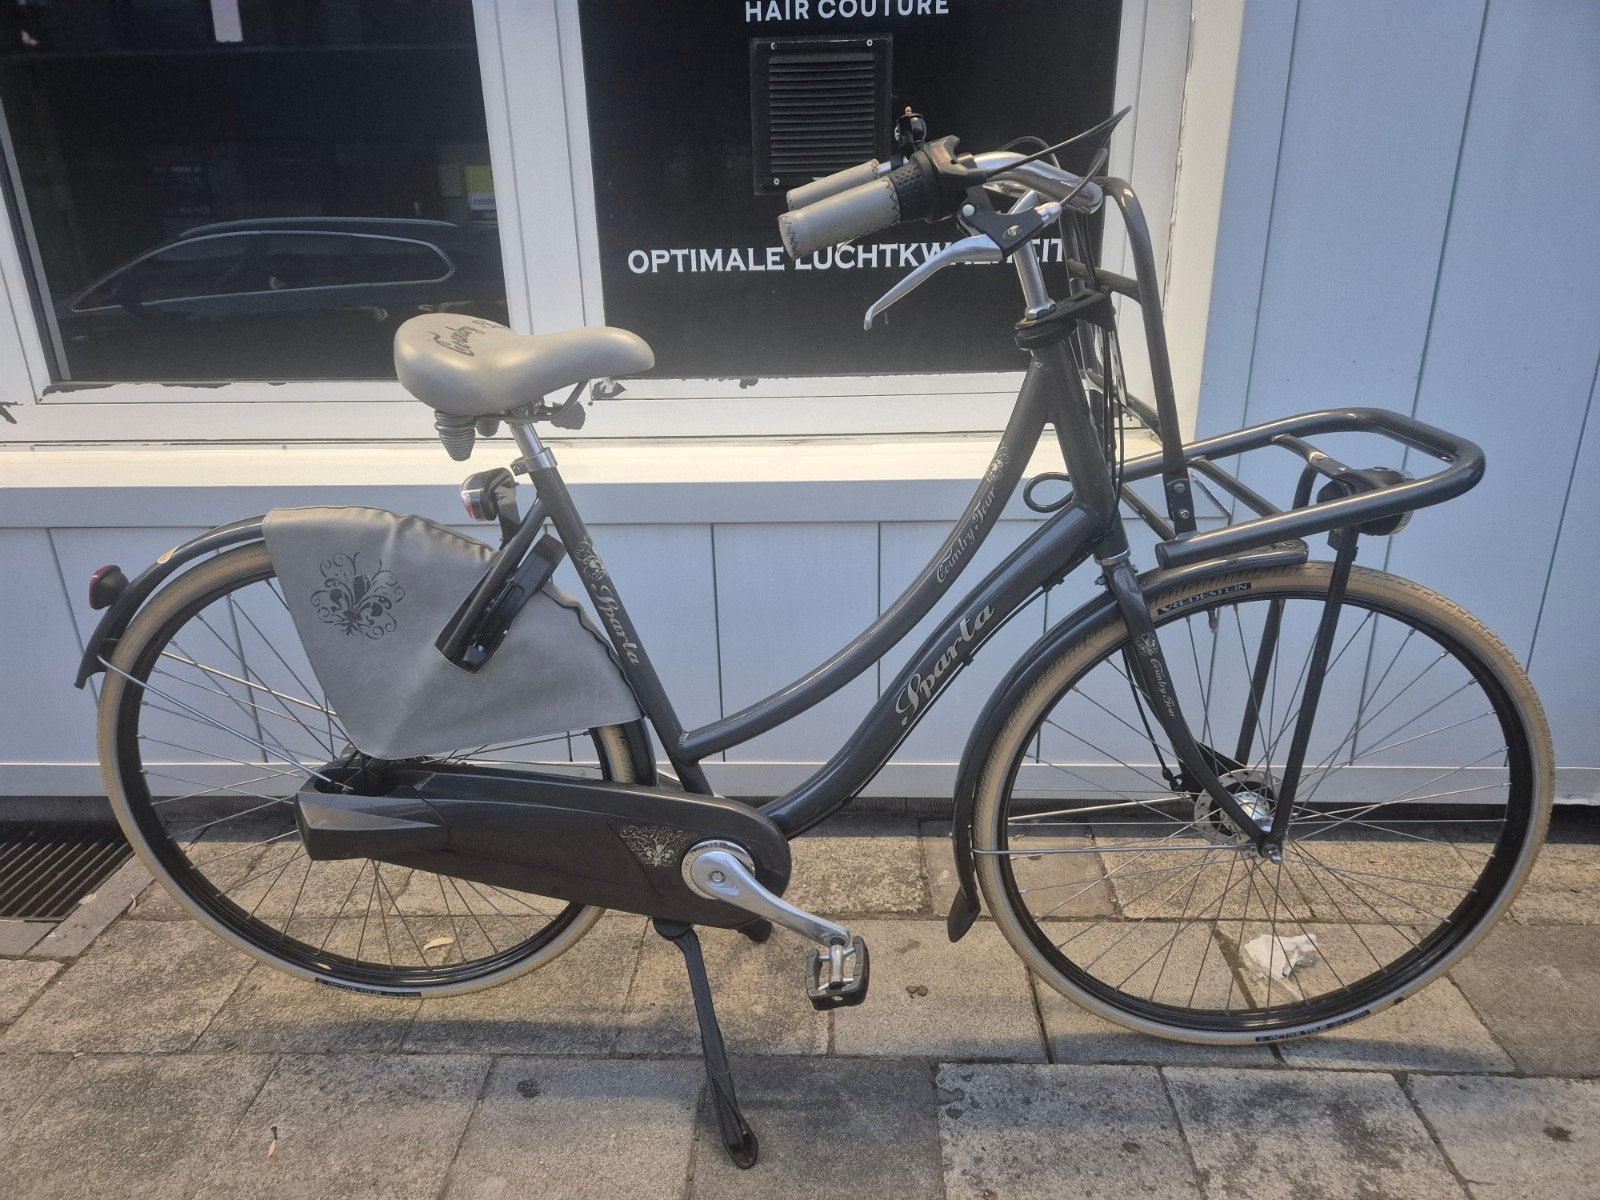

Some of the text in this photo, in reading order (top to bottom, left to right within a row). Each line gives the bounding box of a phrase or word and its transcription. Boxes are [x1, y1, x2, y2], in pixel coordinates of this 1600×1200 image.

[745, 0, 949, 22] HAIR COUTURE
[627, 246, 785, 274] OPTIMALE
[936, 528, 976, 583] Country
[590, 583, 640, 666] Sparta
[895, 604, 995, 727] Sparta
